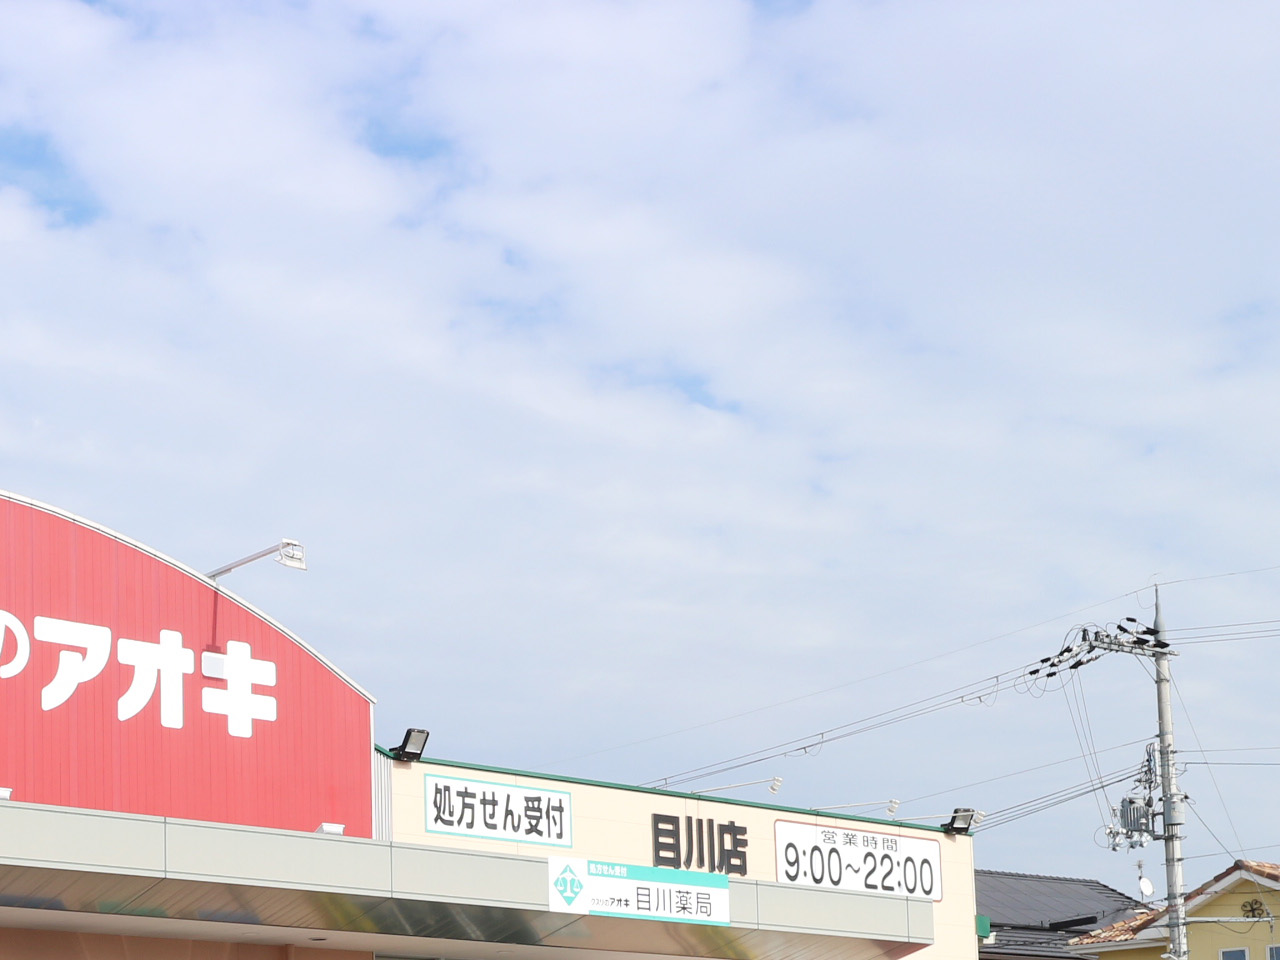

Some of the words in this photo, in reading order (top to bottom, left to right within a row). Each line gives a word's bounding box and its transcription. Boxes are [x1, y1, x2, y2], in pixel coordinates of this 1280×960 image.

[432, 781, 566, 841] 処方せん受付
[651, 812, 749, 876] 目川店
[821, 829, 899, 852] 営業時間
[589, 863, 628, 877] 処方せん受付
[591, 897, 631, 908] クスリのアオキ
[636, 886, 712, 917] 目川薬局
